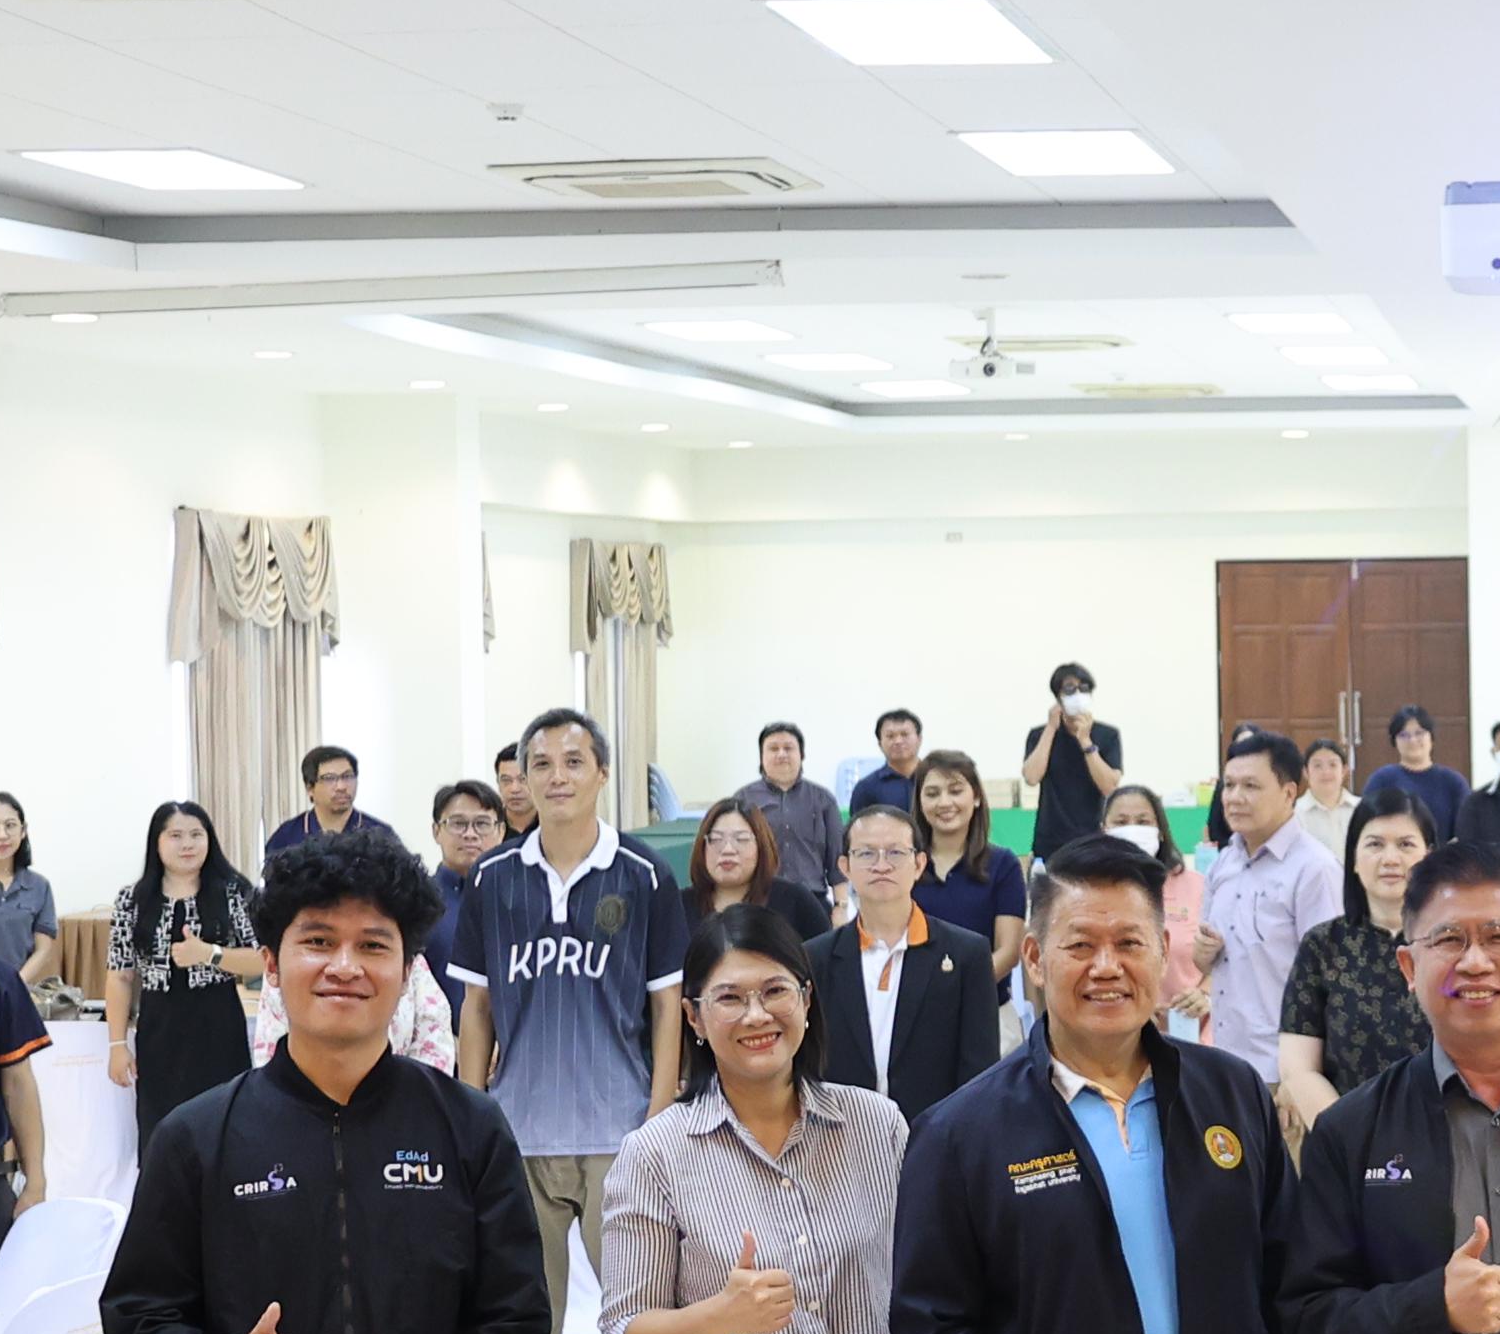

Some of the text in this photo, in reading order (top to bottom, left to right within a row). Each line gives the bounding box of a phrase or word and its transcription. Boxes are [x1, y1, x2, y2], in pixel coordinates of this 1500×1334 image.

[508, 936, 611, 984] KPRU
[396, 1150, 429, 1163] EdAd
[383, 1163, 443, 1183] CMU
